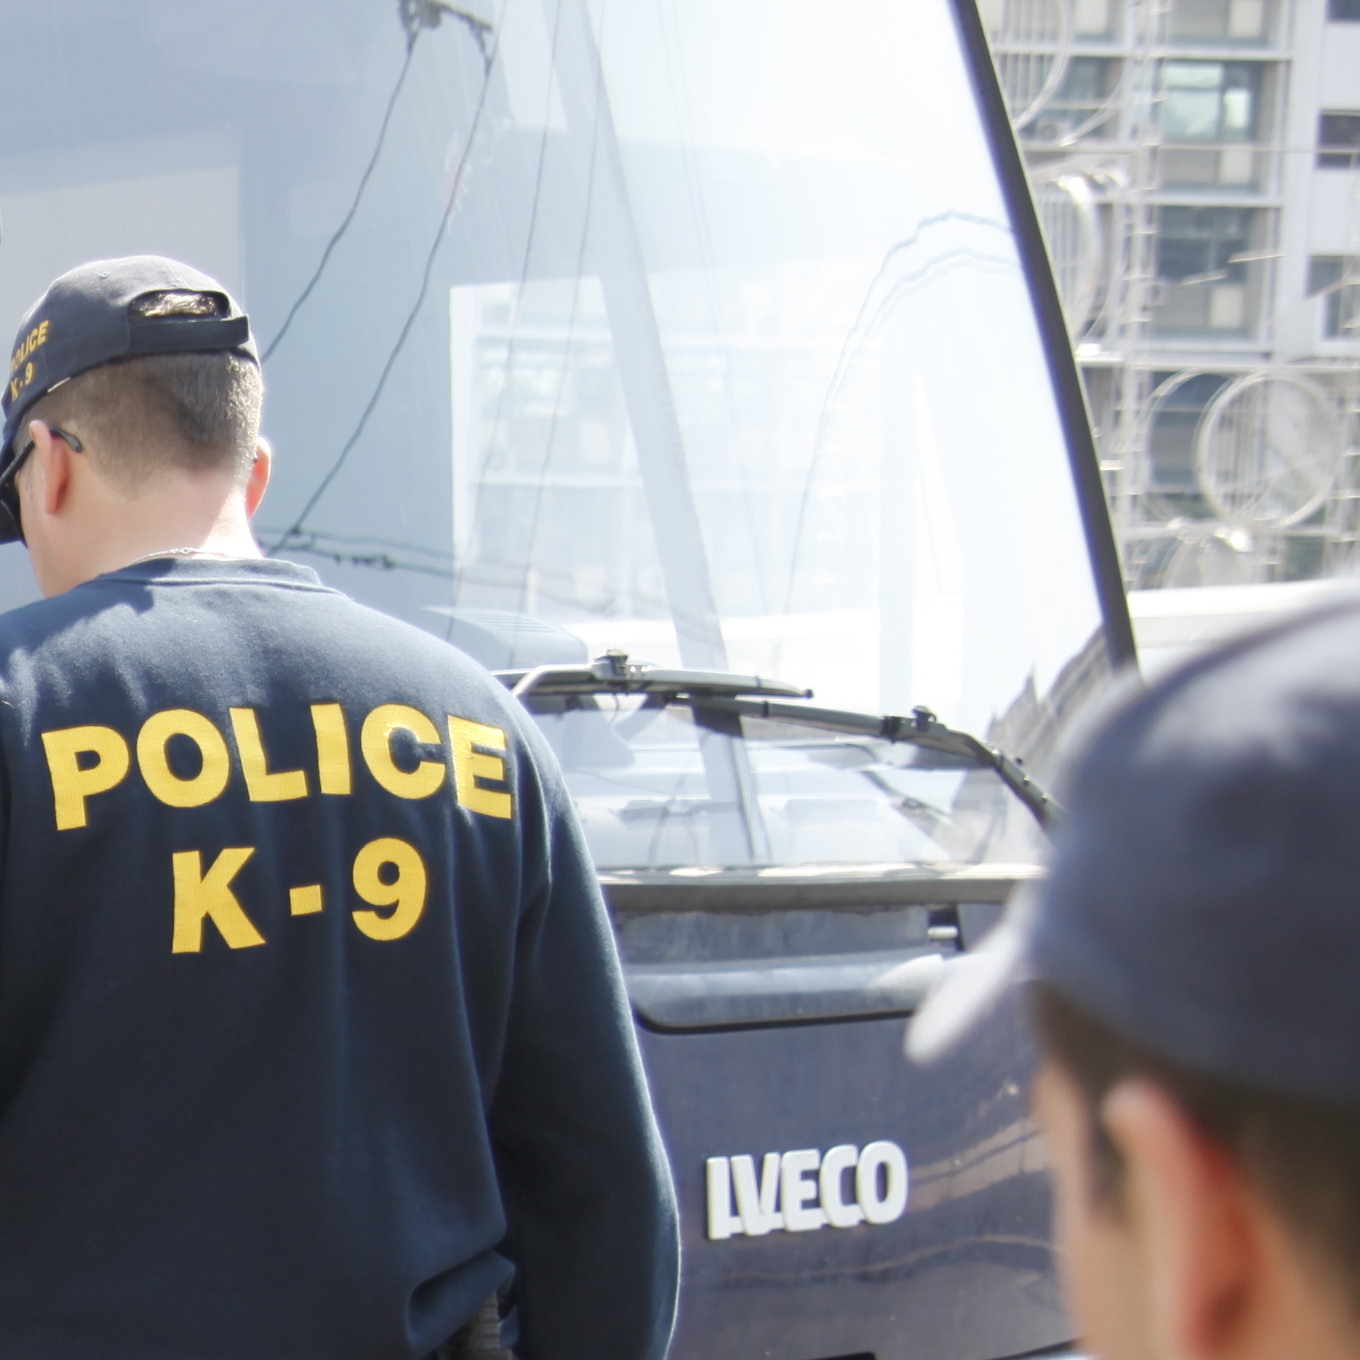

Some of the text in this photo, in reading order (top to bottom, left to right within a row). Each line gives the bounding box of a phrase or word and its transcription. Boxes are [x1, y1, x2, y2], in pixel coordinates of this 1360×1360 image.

[10, 361, 34, 402] K-9
[41, 702, 512, 831] POLICE
[706, 1140, 909, 1240] IVECO
